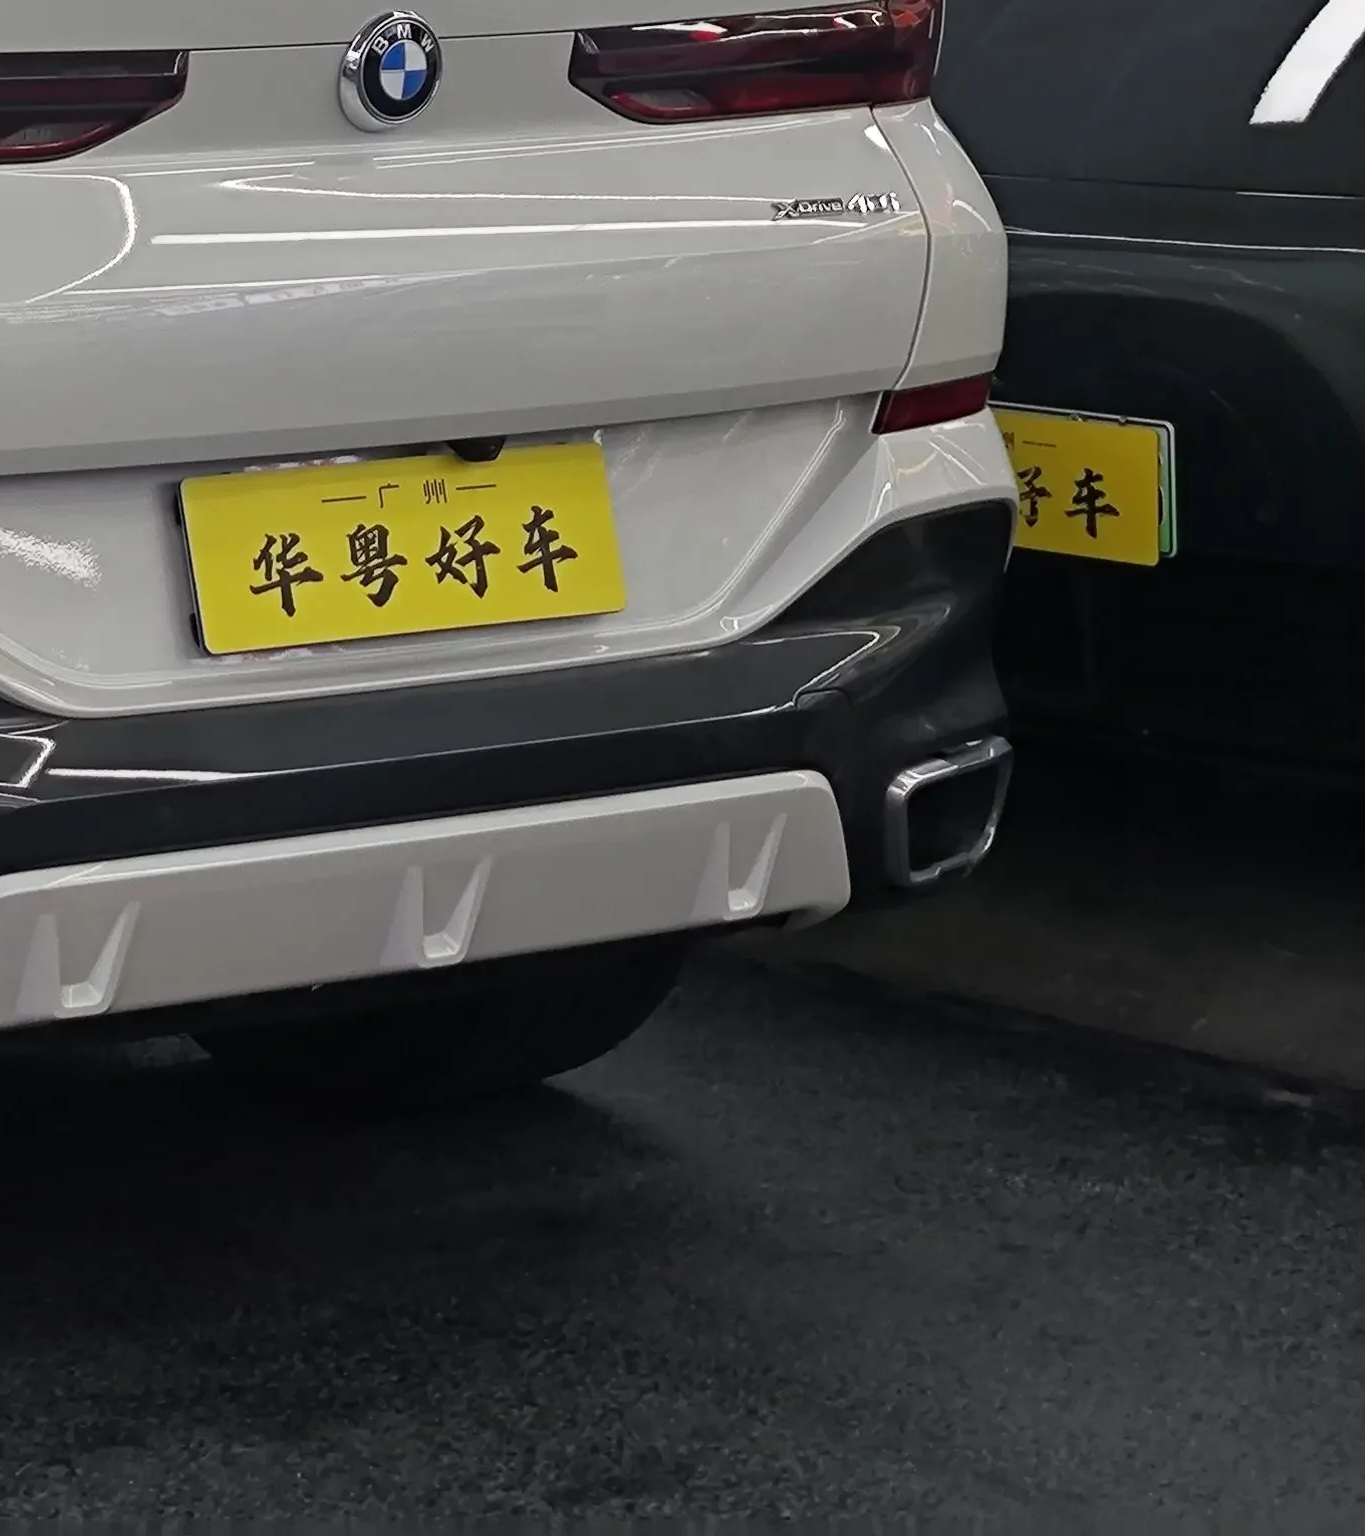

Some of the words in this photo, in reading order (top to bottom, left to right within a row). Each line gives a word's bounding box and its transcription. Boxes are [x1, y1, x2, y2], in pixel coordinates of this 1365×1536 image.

[372, 23, 434, 56] BMW
[377, 478, 449, 509] 广州
[249, 505, 579, 618] 华粤好车
